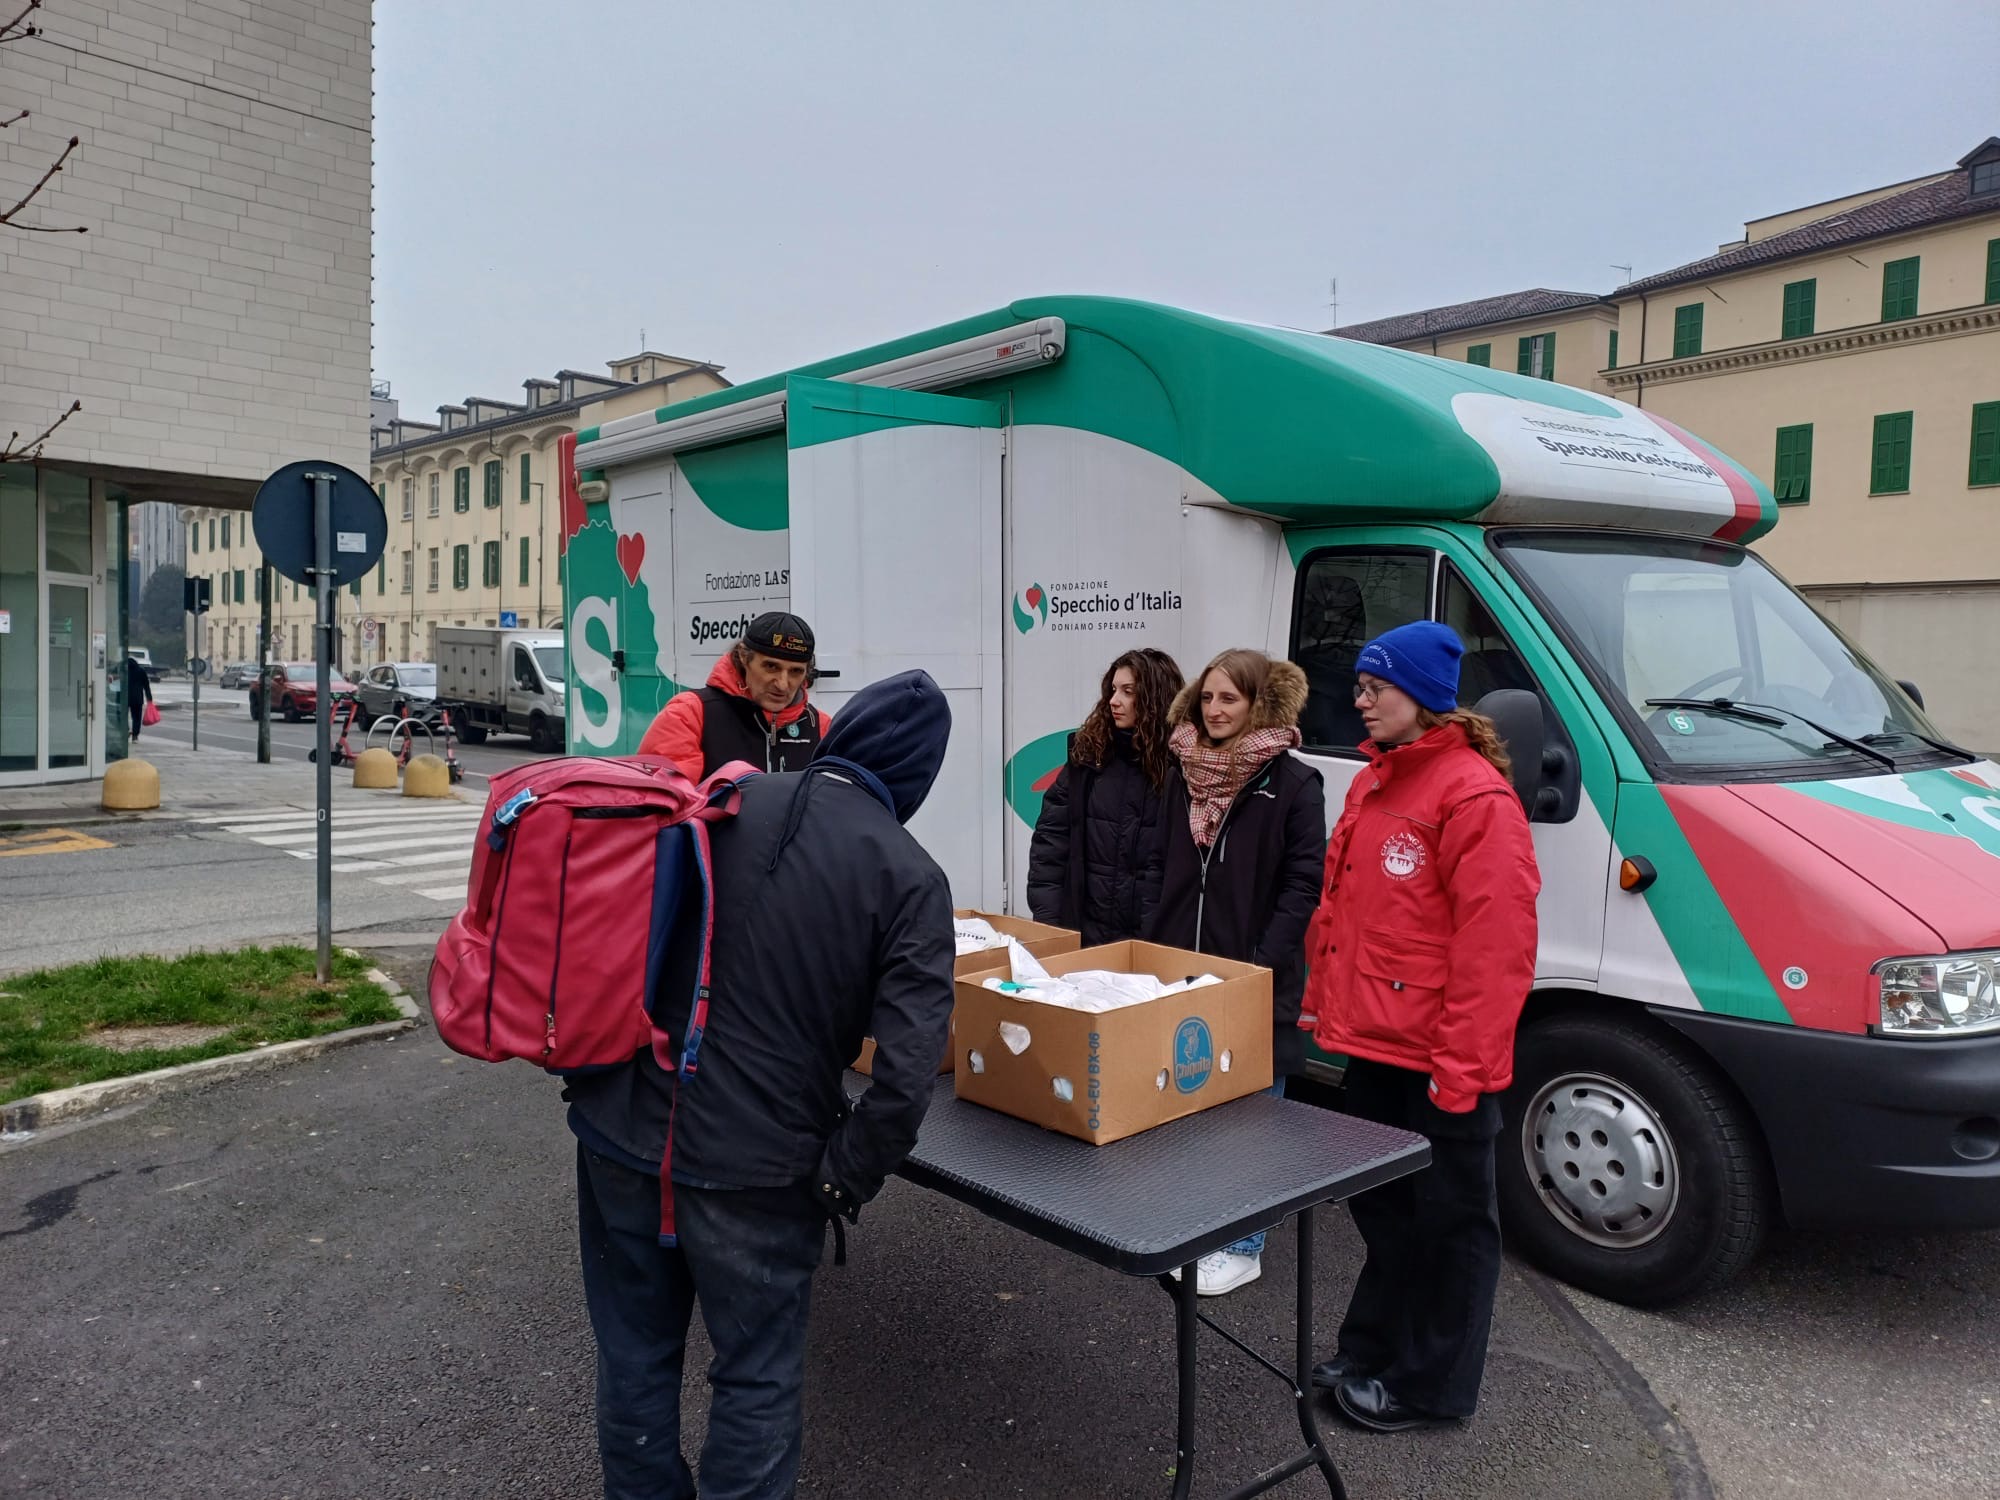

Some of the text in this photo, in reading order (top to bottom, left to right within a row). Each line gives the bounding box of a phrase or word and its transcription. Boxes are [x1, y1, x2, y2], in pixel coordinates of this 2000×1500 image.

[1536, 436, 1638, 463] Specchio
[705, 570, 761, 591] Fondazione
[1050, 580, 1109, 592] FONDAZIONE
[1050, 590, 1182, 618] Specchio d’Italia
[690, 613, 756, 645] Specch
[1051, 621, 1146, 632] DONIAMO SPERANZA
[571, 595, 622, 749] S
[1380, 831, 1426, 866] CITY ANGELS
[1175, 1055, 1211, 1080] Chiquita
